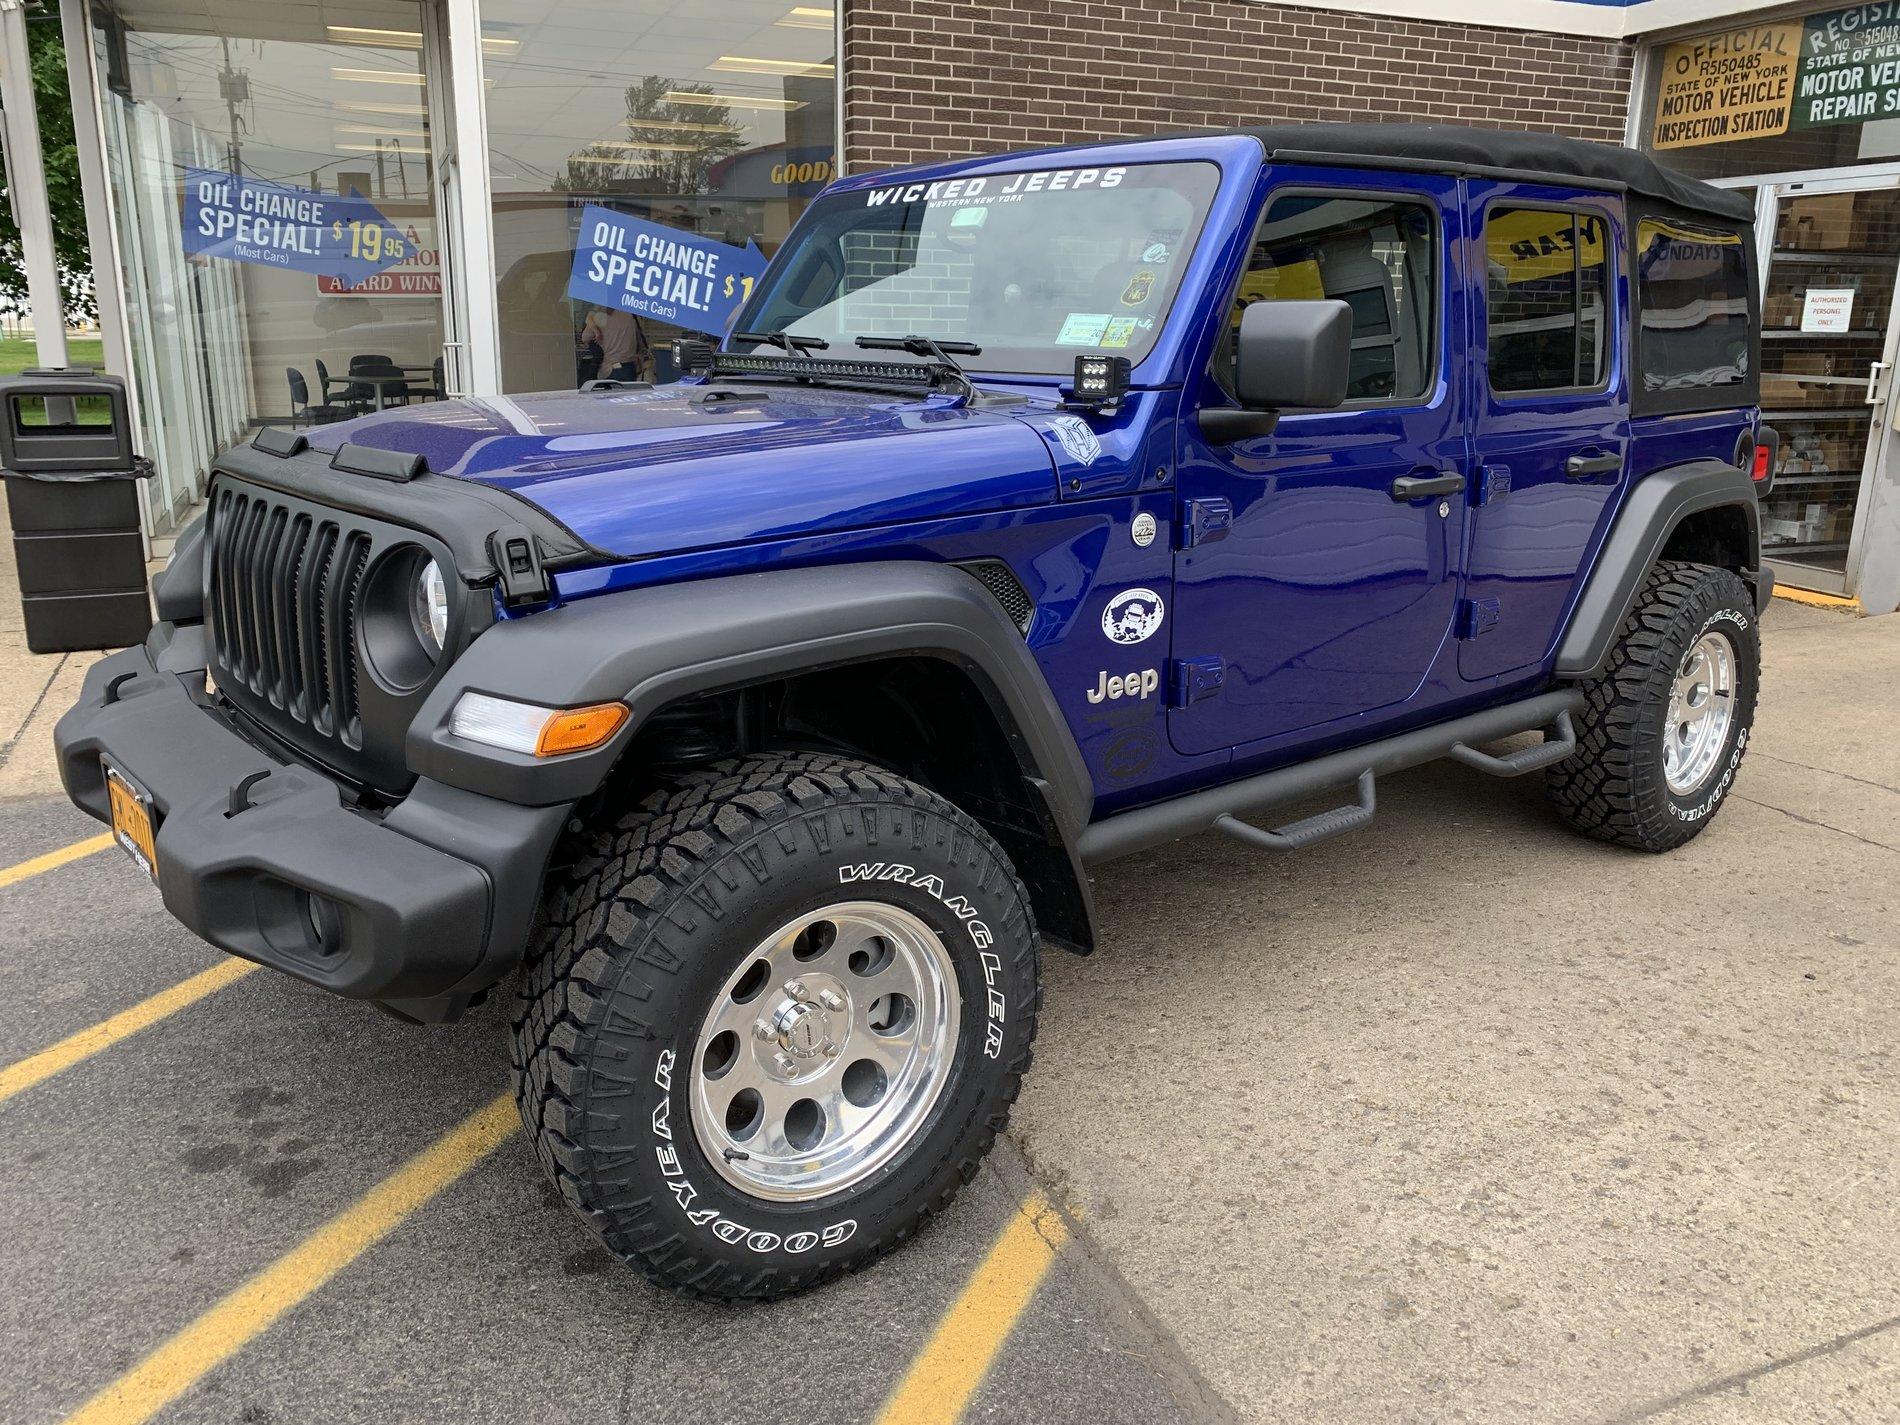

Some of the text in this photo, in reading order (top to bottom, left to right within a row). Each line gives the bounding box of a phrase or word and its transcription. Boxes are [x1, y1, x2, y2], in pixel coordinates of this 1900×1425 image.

[1809, 1, 1900, 54] REGIST
[1834, 38, 1851, 52] NO.
[1675, 29, 1788, 75] OFFICIAL
[1699, 53, 1762, 77] R5150485
[1806, 52, 1848, 70] STATE
[1852, 48, 1872, 63] OF
[1662, 78, 1788, 117] MOTOR VEHICLE
[1666, 64, 1788, 95] STATE OF NEW YORK
[1800, 66, 1864, 98] MOTOR
[1809, 91, 1878, 122] REPAIR
[1657, 107, 1785, 143] INSPECTION STATION
[198, 181, 324, 225] OIL CHANGE
[866, 167, 1128, 207] WICKED JEEPS
[928, 192, 1025, 209] WESTERN NEW YORK
[198, 207, 322, 256] SPECIAL!
[233, 244, 290, 265] (Most Cars)
[592, 221, 720, 279] OIL CHANGE
[329, 275, 393, 291] AARD
[588, 250, 714, 312] SPECIAL!
[621, 294, 677, 320] (Most Cars)
[1086, 668, 1159, 704] Jeep
[1668, 727, 1747, 822] GOODYEAR
[839, 862, 1006, 1060] WRANGLER
[652, 1049, 858, 1254] GOODYEAR
